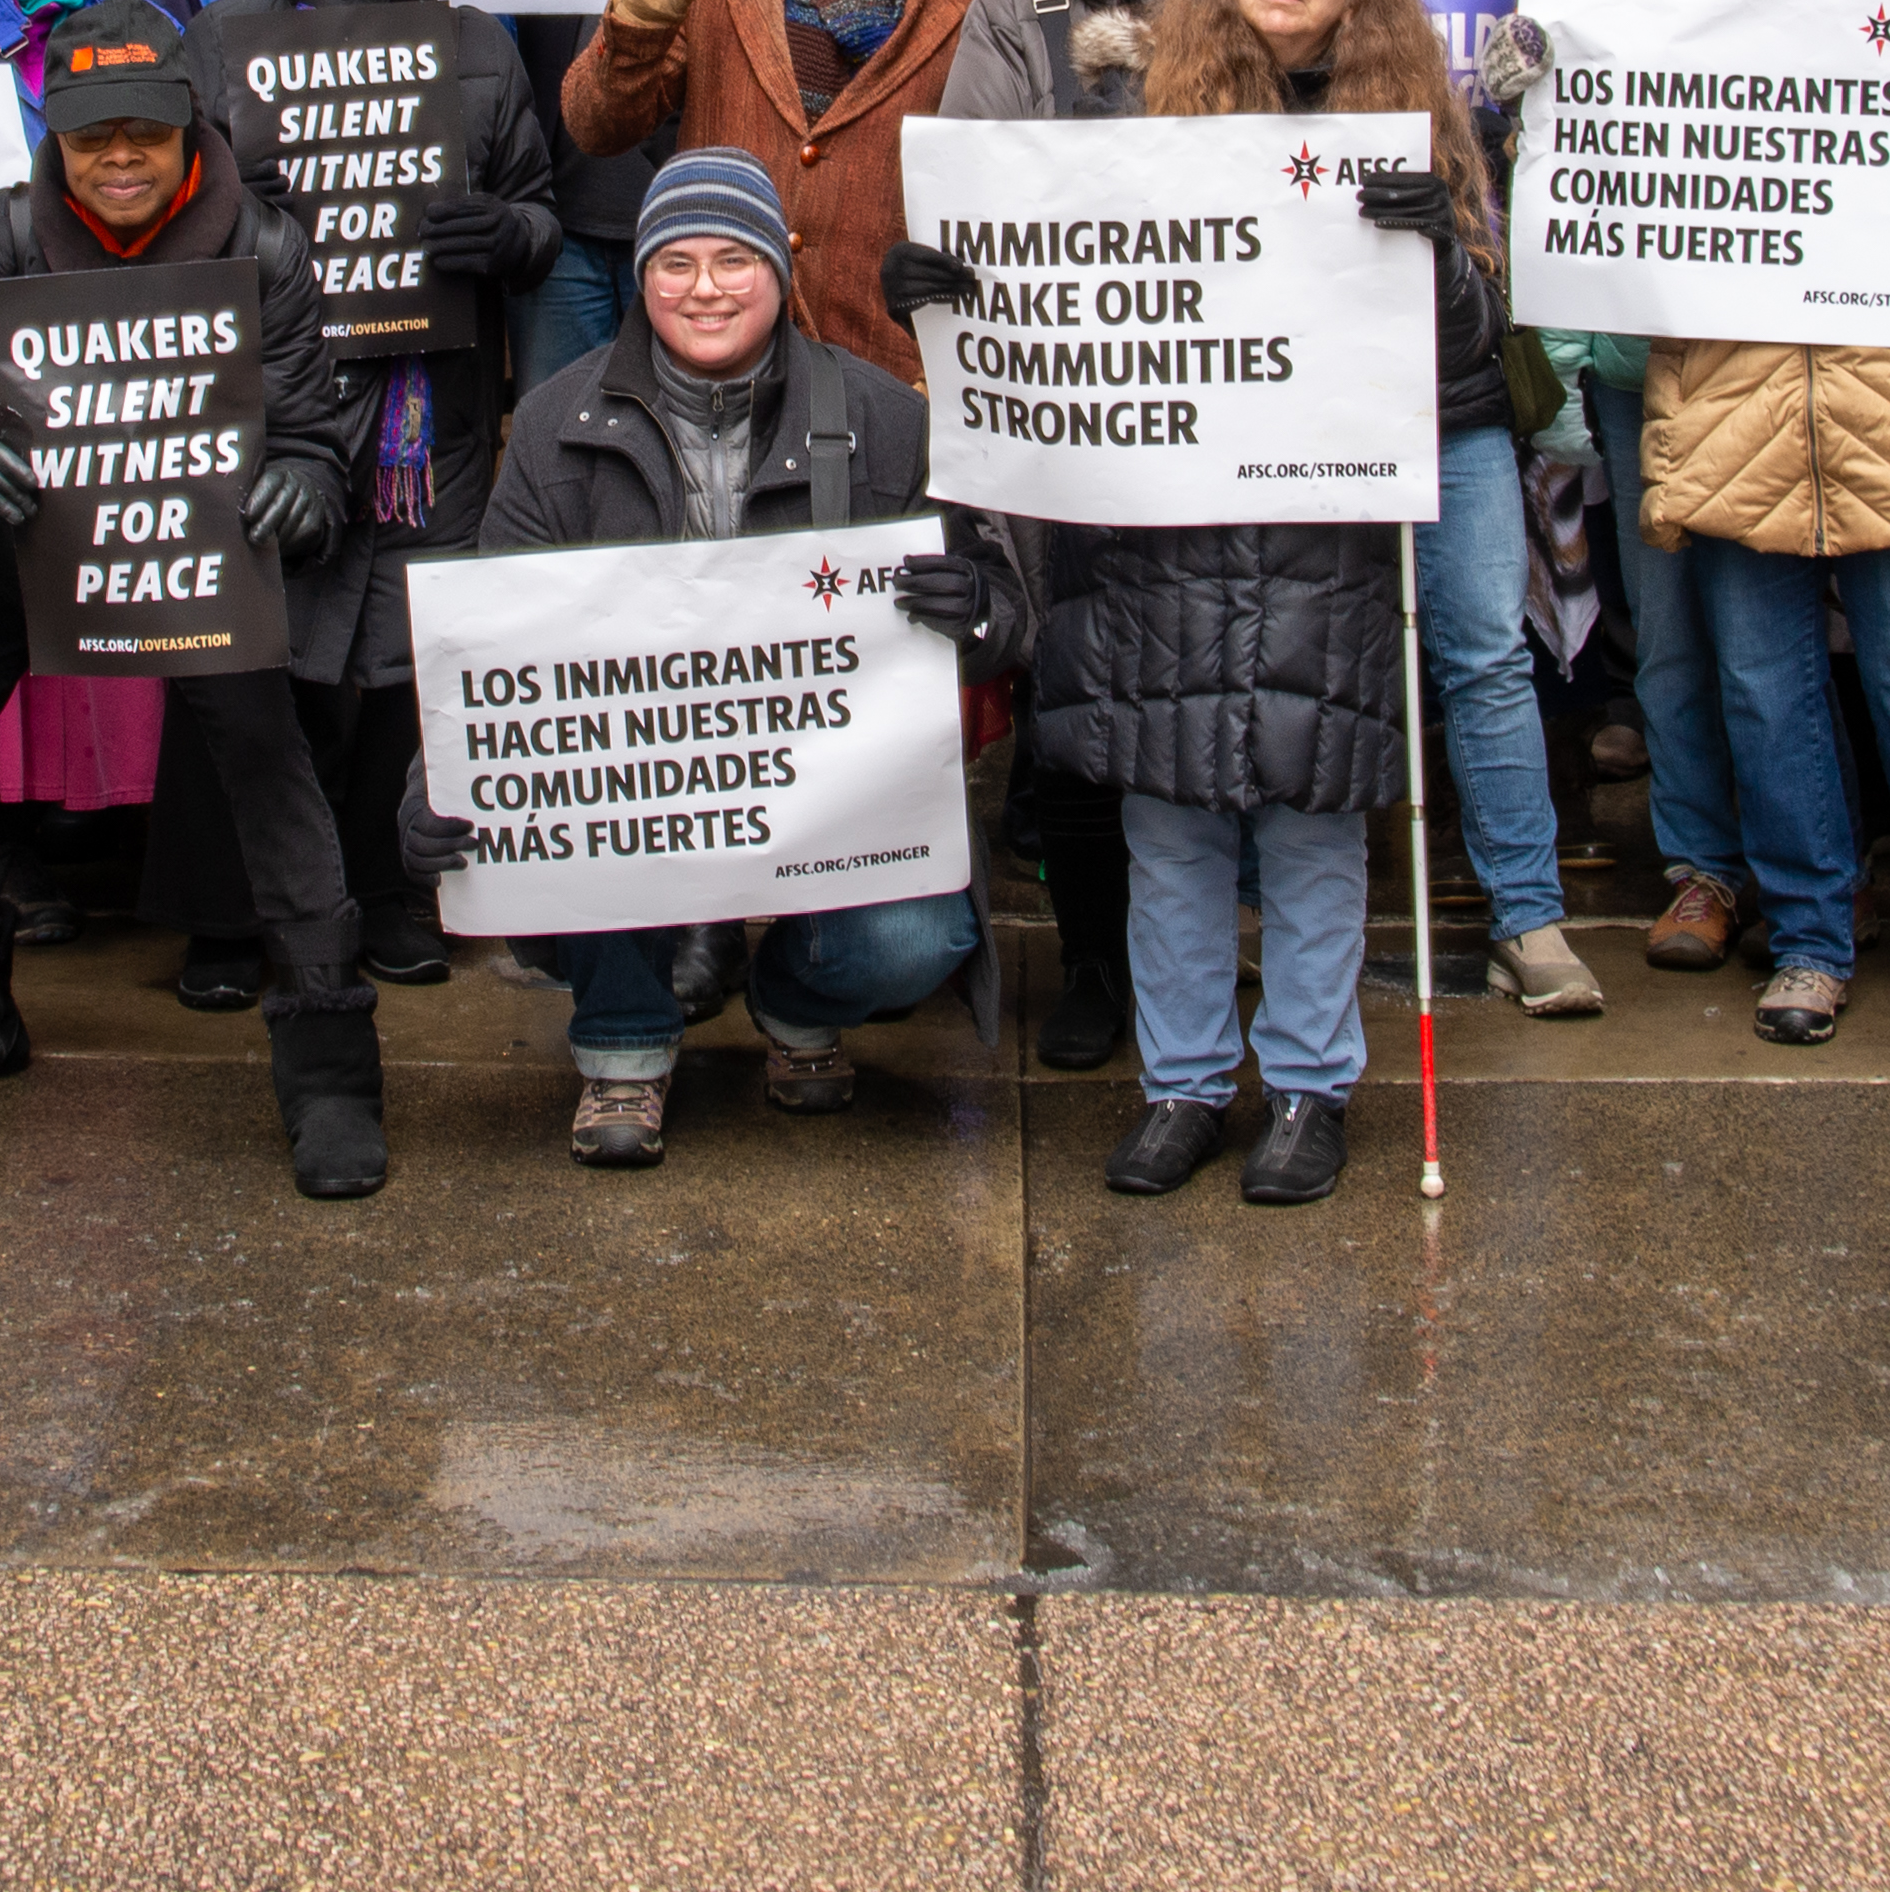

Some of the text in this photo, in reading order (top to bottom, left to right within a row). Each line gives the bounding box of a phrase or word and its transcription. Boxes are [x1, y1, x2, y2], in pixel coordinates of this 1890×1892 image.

[247, 44, 438, 103] QUAKERS
[1555, 68, 1612, 105] LOS
[278, 96, 420, 143] SILENT
[1554, 118, 1890, 167] HACEN NUESTRAS
[1550, 168, 1833, 216] COMUNIDADES
[314, 203, 398, 243] FOR
[939, 216, 1261, 267] IMMIGRANTS
[1545, 209, 1804, 266] MÁS FUERTES
[322, 318, 430, 338] ORG/LOVEASACTION
[952, 280, 1204, 327] MAKE OUR
[11, 311, 238, 380] QUAKERS
[956, 331, 1293, 387] COMMUNITIES
[46, 373, 215, 429] SILENT
[962, 388, 1199, 447] STRONGER
[30, 430, 240, 489] WITNESS
[1237, 462, 1398, 481] AFSC.ORG/STRONGER
[93, 498, 190, 546] FOR
[76, 553, 223, 604] PEACE
[79, 632, 231, 653] AFSC.ORG/LOVEASACTION
[462, 634, 859, 708] LOS INMIGRANTES
[467, 688, 851, 760] HACEN NUESTRAS
[471, 748, 796, 810] COMUNIDADES
[476, 805, 771, 864] MÁS FUERTES
[775, 845, 930, 879] AFSC.ORG/STRONGER
